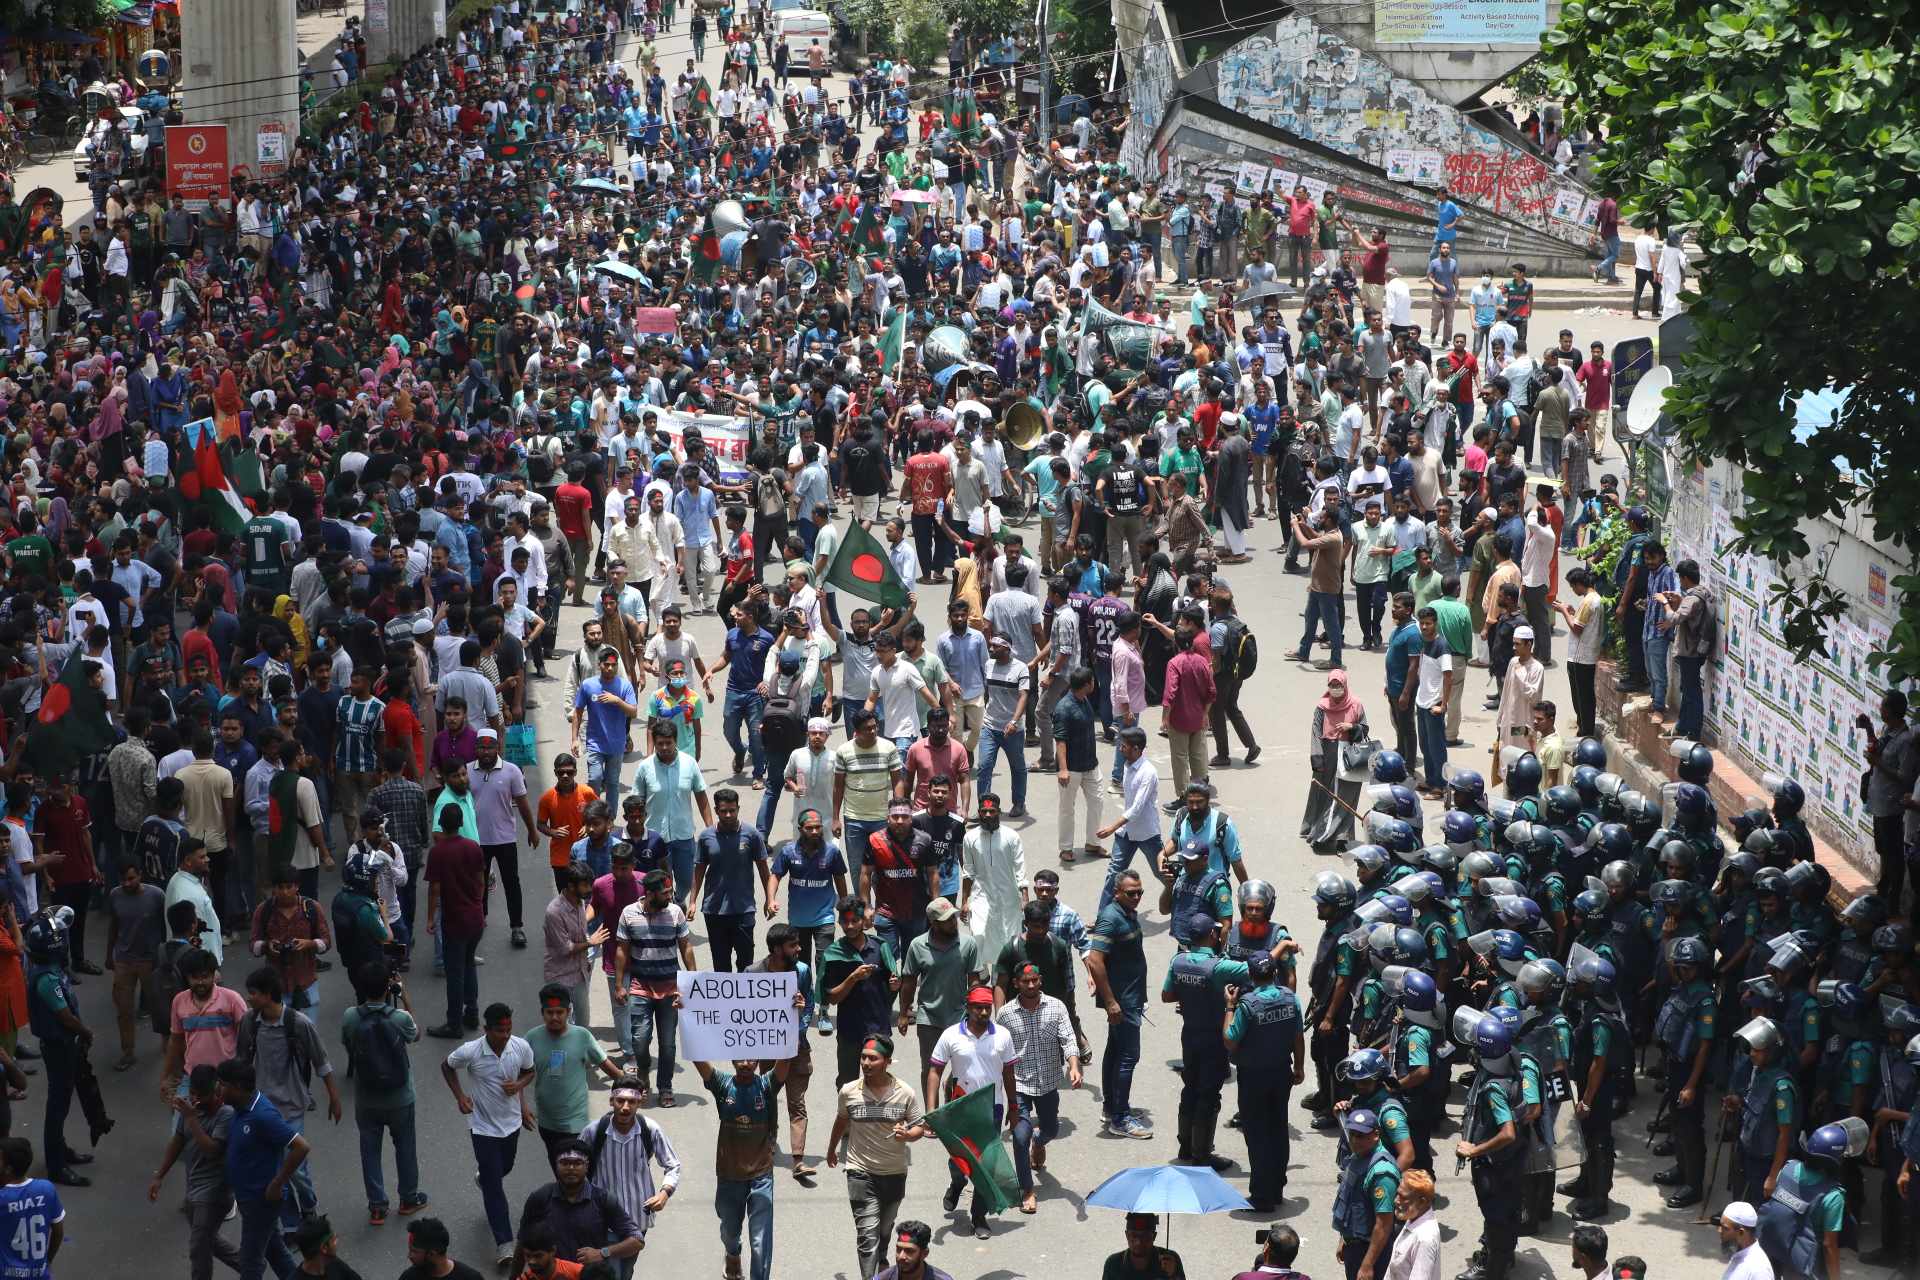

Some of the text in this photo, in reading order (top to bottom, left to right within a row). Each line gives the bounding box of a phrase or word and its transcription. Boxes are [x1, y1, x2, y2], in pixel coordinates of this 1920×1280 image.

[1460, 13, 1485, 22] Activity
[1486, 13, 1507, 21] Based
[254, 537, 266, 562] 1
[1176, 974, 1202, 985] POLICE
[689, 978, 787, 1000] ABOLISH
[692, 1008, 789, 1025] THE QUOTA
[1257, 1005, 1296, 1023] POLICE
[724, 1028, 787, 1048] SYSTEM
[7, 1195, 46, 1213] RIAZ
[10, 1214, 48, 1260] 46
